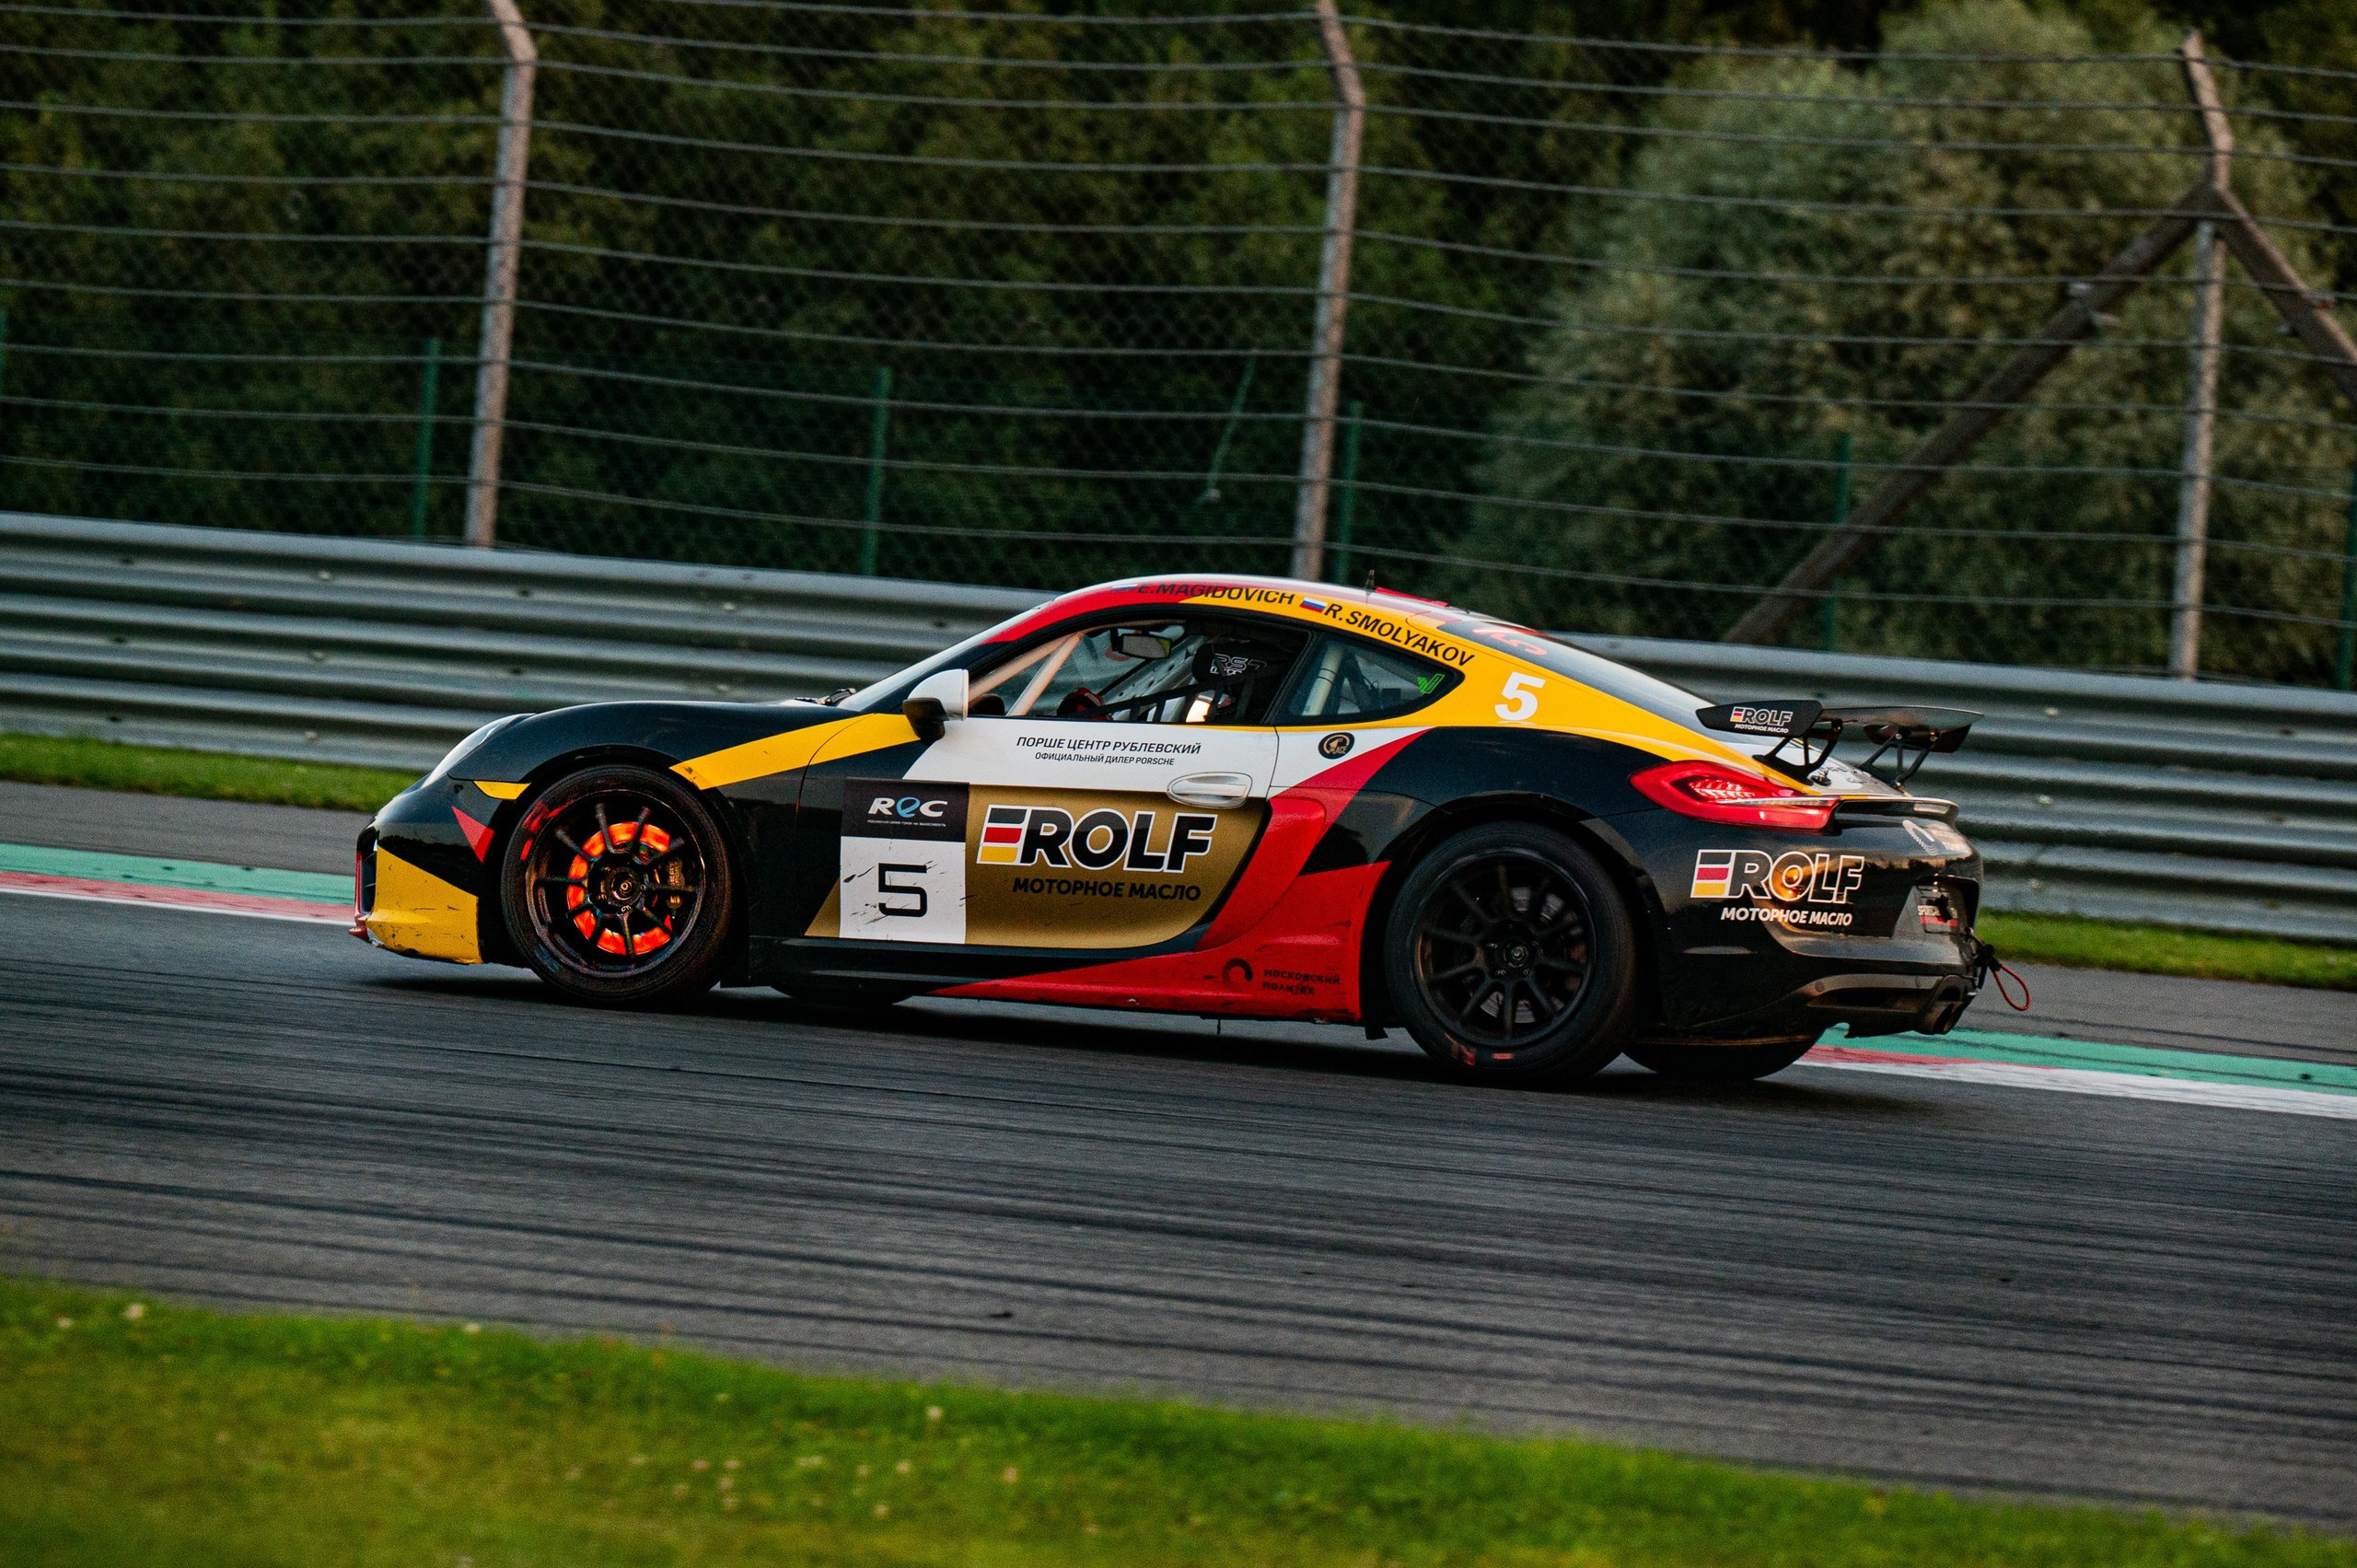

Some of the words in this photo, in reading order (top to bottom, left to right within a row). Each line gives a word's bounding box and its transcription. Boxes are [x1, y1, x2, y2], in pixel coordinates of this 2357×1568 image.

[1324, 603, 1476, 667] R.SMOLYAKOV
[1494, 670, 1547, 721] 5
[1743, 707, 1794, 726] ROLF
[1016, 737, 1065, 749] ПОРШЕ
[1067, 739, 1110, 751] ЦЕНТР
[1112, 742, 1202, 754] РУБЛЕВСКИЙ
[1035, 751, 1105, 762] ОФИЦИАЛЬНЫЙ
[1105, 755, 1134, 764] ДИЛЕР
[1135, 757, 1175, 765] PORSCHE
[1018, 807, 1218, 873] ROLF
[1013, 877, 1124, 898] МОТОРНОЕ
[1128, 882, 1202, 900] МАСЛО
[1727, 850, 1865, 904] ROLF
[878, 863, 927, 917] 5
[1721, 907, 1806, 923] МОТОРНОЕ
[1808, 911, 1852, 926] МАСЛО
[1264, 970, 1341, 984] МОСКОВСКИЙ
